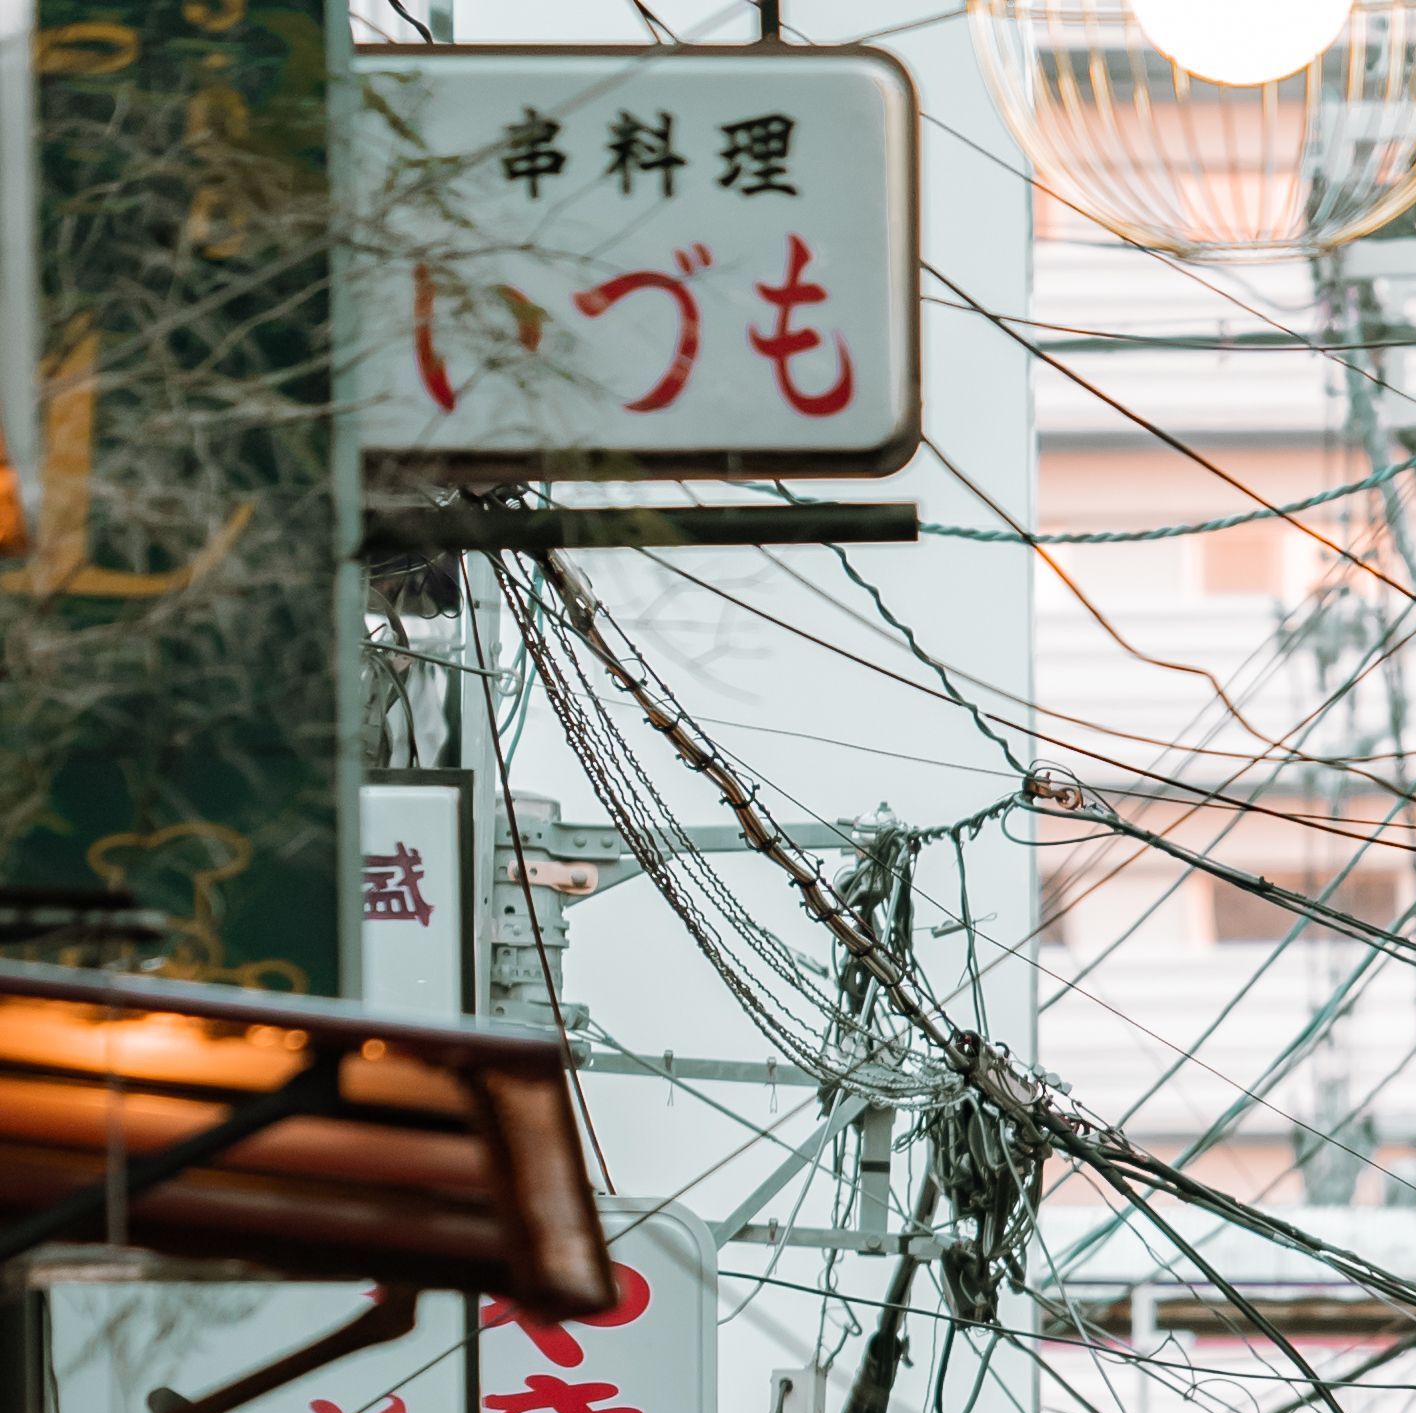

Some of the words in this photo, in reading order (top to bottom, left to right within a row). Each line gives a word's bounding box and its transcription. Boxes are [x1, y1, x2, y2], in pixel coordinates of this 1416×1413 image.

[499, 108, 802, 199] 串料理
[412, 233, 856, 417] いづも
